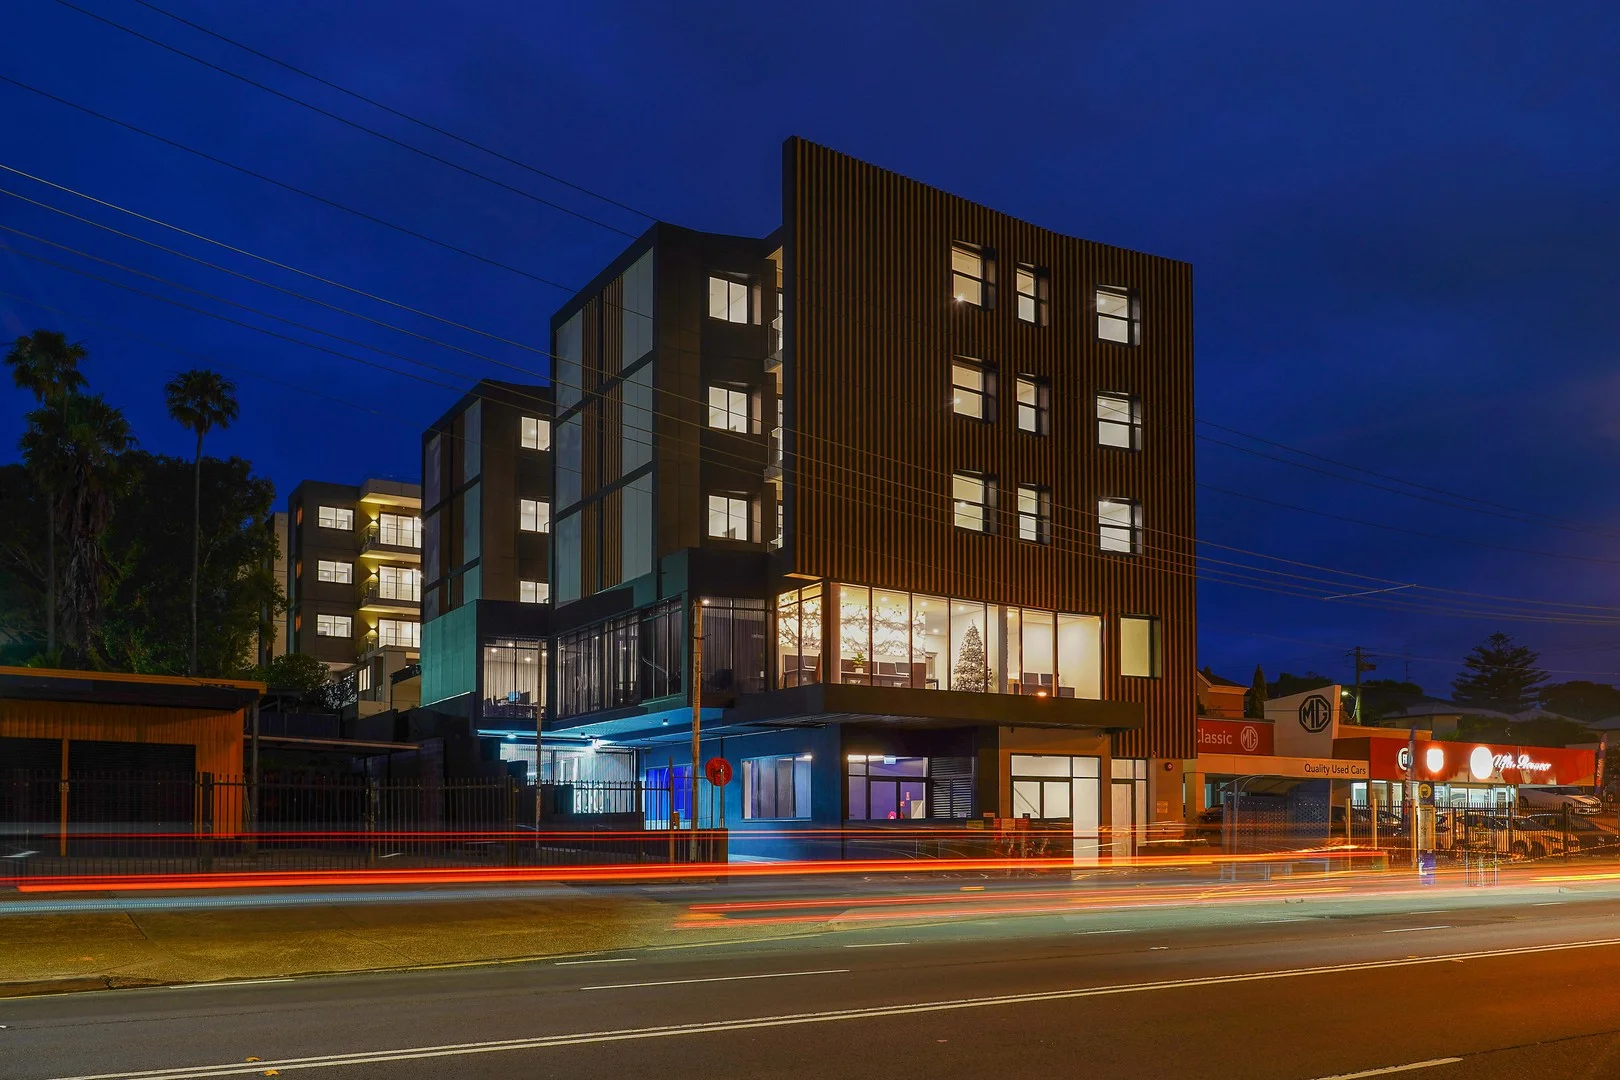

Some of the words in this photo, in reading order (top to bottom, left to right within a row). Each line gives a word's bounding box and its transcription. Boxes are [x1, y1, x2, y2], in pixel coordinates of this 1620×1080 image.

[1301, 698, 1330, 730] MG
[1242, 728, 1257, 750] MG
[1304, 763, 1330, 776] Quality
[1331, 764, 1349, 774] Used
[1351, 765, 1366, 775] Cars
